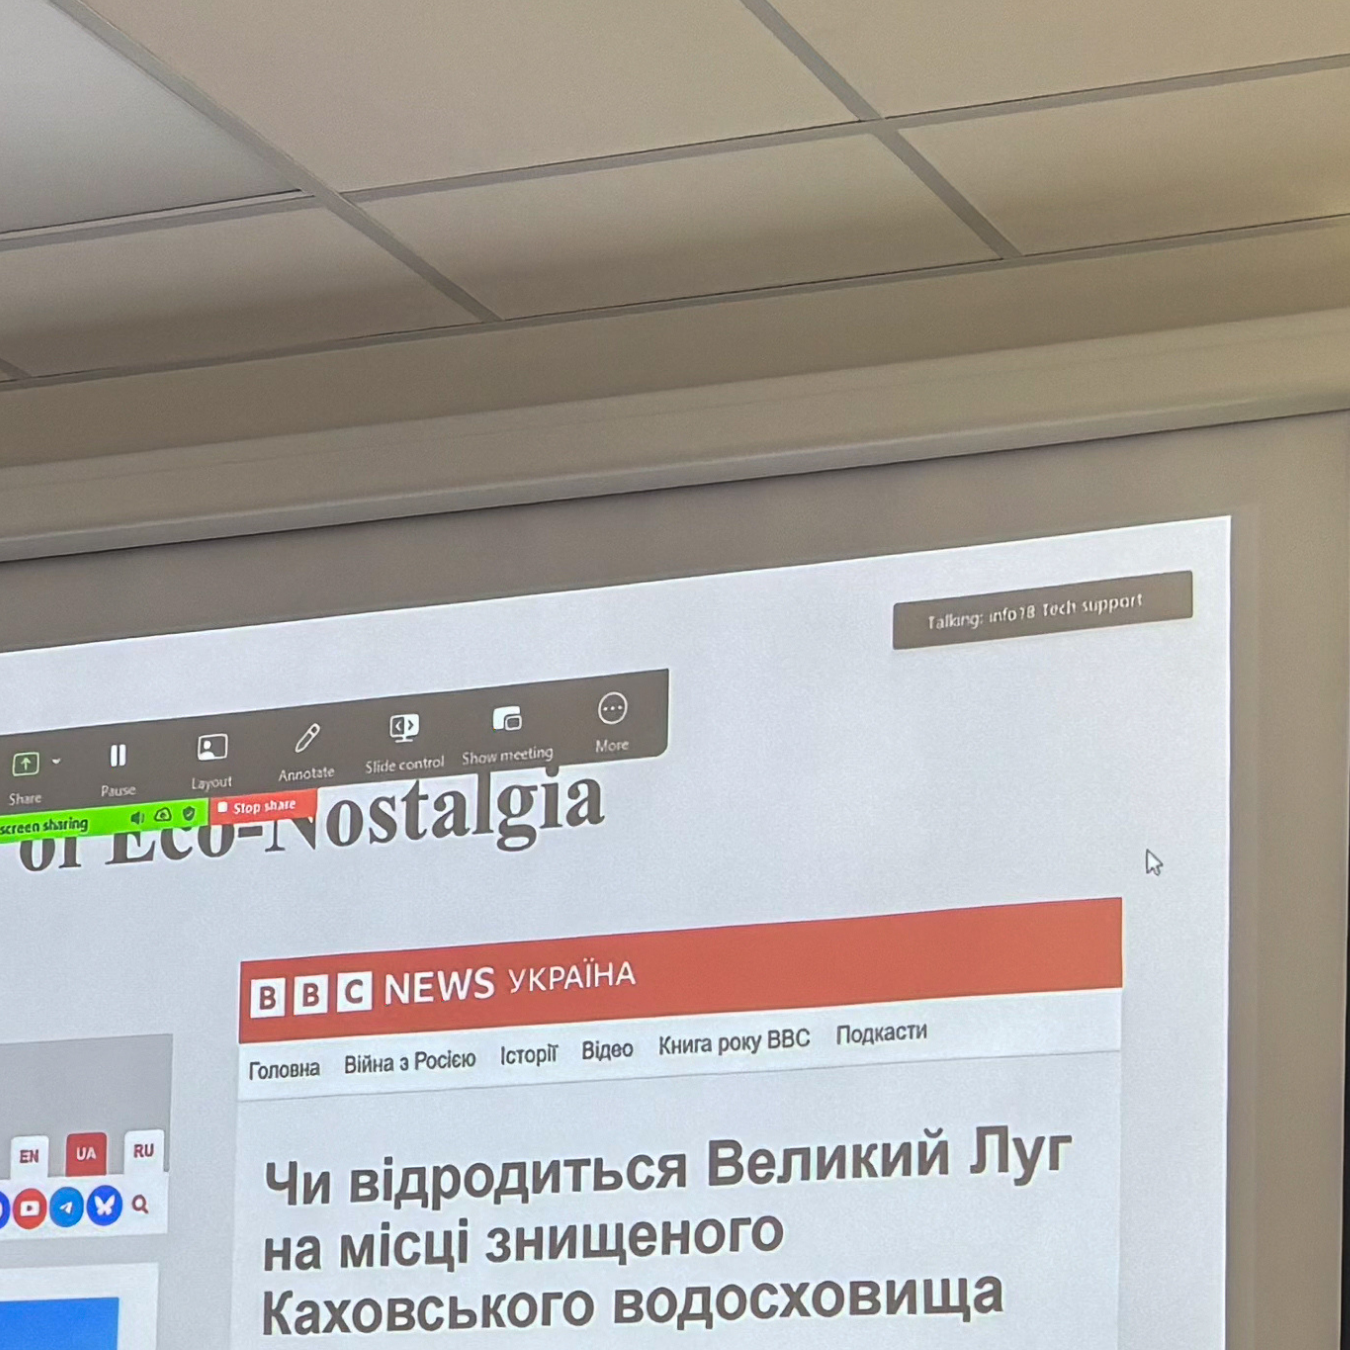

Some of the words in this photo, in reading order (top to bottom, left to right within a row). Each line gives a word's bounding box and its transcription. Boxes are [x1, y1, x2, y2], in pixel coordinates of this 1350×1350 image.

[928, 612, 983, 631] Talking:
[1042, 600, 1077, 617] Tech
[1082, 593, 1143, 615] support
[462, 747, 495, 766] Show
[499, 745, 554, 767] meeting
[595, 737, 630, 754] More
[278, 764, 335, 782] Annotate
[365, 757, 396, 775] Slide
[399, 754, 446, 772] control
[101, 783, 136, 799] Pause
[191, 775, 233, 793] Layout
[9, 790, 42, 805] Share
[233, 799, 260, 816] Stop
[263, 798, 296, 812] share
[0, 822, 40, 835] screen
[42, 817, 88, 832] sharing
[254, 975, 369, 1014] BBC
[384, 966, 495, 1006] NEWS
[508, 958, 636, 994] УКРАЇНА
[837, 1021, 928, 1046] Подкасти
[501, 1043, 559, 1065] Історії
[582, 1040, 634, 1063] Відео
[659, 1034, 712, 1055] Книга
[717, 1034, 763, 1056] року
[249, 1060, 320, 1081] Головна
[345, 1054, 395, 1074] Війна
[399, 1058, 409, 1072] з
[414, 1050, 476, 1070] Росією
[20, 1149, 40, 1164] EN
[76, 1145, 97, 1161] UA
[133, 1143, 155, 1159] RU
[265, 1162, 331, 1208] Чи
[350, 1151, 688, 1212] відродиться
[707, 1128, 950, 1187] Великий
[970, 1125, 1073, 1187] Луг
[263, 1232, 322, 1272] на
[339, 1220, 470, 1273] місці
[485, 1214, 784, 1265] знищеного
[262, 1287, 595, 1337] Каховського
[614, 1275, 1005, 1331] водосховища
